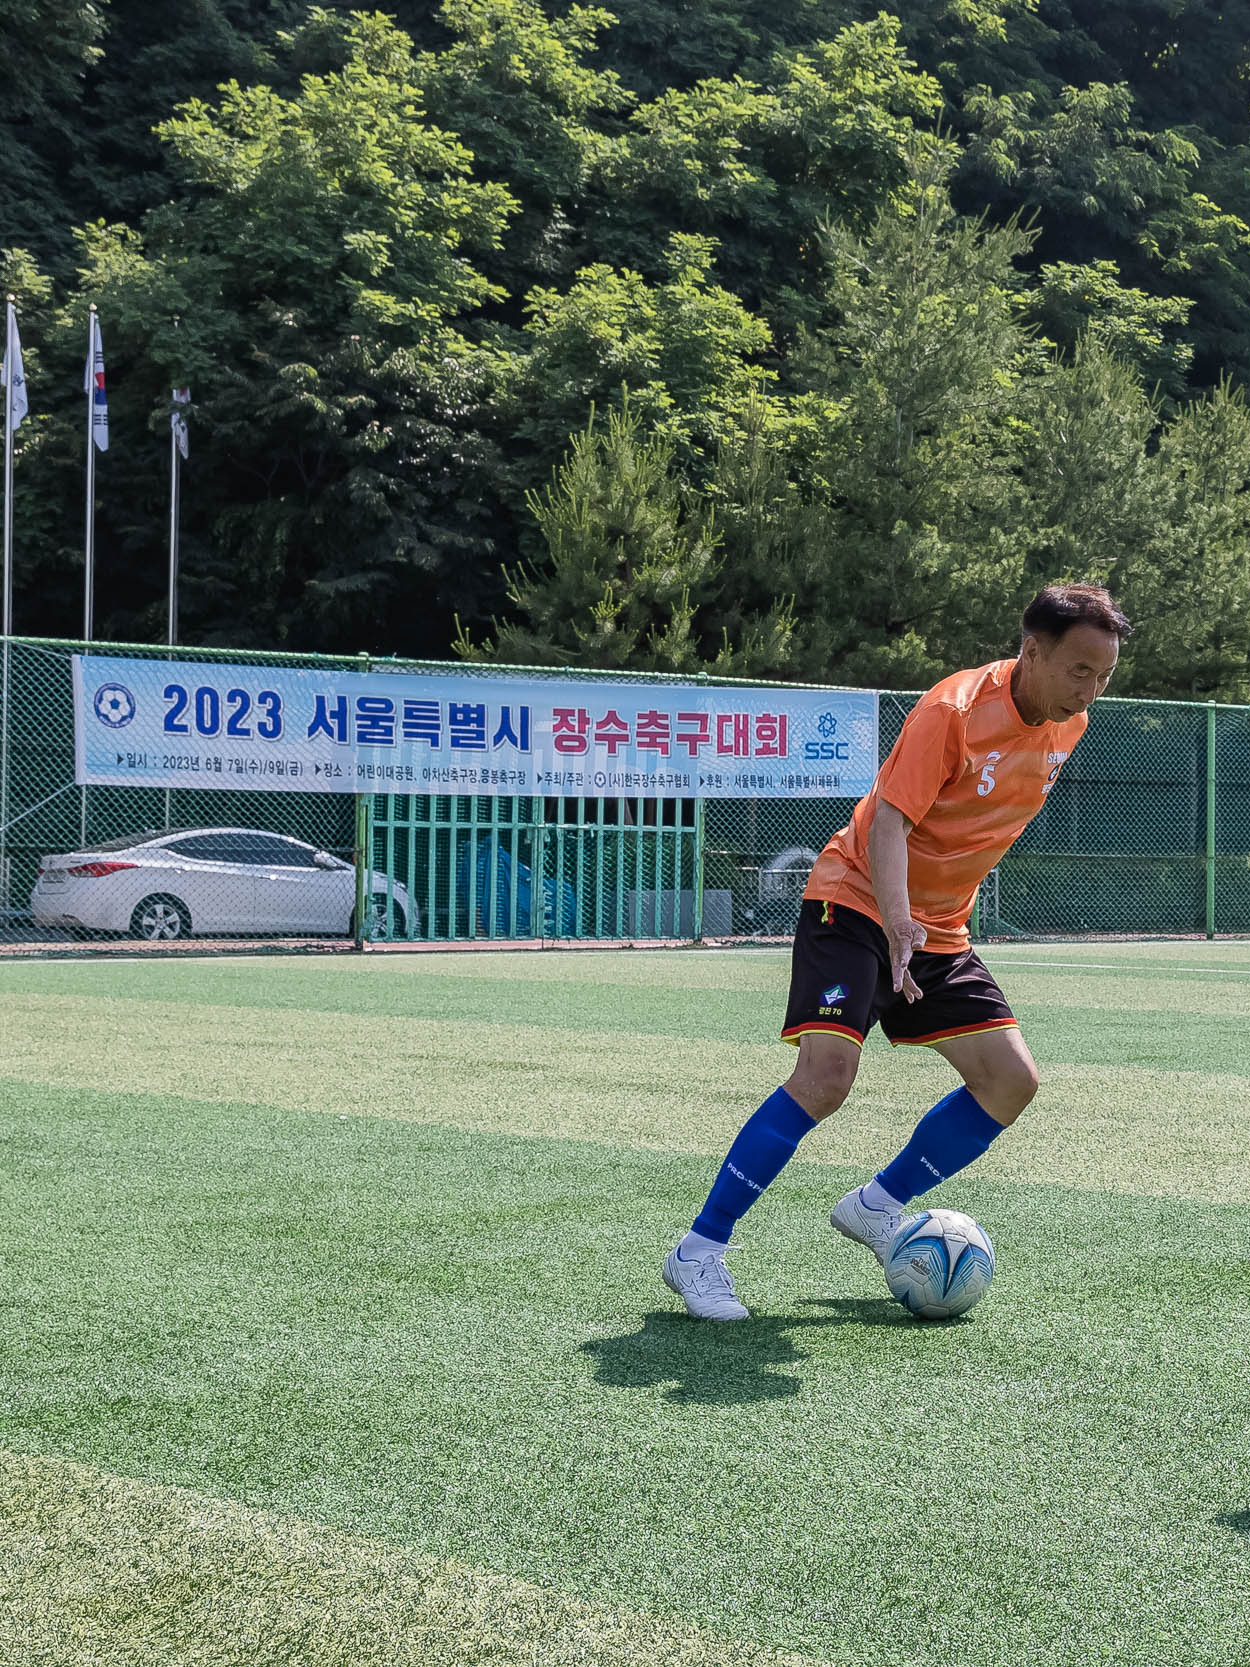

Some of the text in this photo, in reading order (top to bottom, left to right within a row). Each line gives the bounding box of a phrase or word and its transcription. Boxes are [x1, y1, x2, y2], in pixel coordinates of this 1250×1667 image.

[163, 684, 284, 740] 2023
[307, 695, 532, 752] 서울특별시
[552, 708, 788, 757] 장수축구대회
[805, 742, 849, 760] SSC
[127, 752, 148, 768] 일시
[163, 754, 200, 772] 2023년
[205, 757, 223, 773] 6월
[228, 758, 304, 777] 7일(수)/9일(금)
[324, 762, 343, 778] 장소
[544, 771, 584, 787] 주최/주관
[706, 774, 723, 789] 후원
[977, 764, 996, 797] 5
